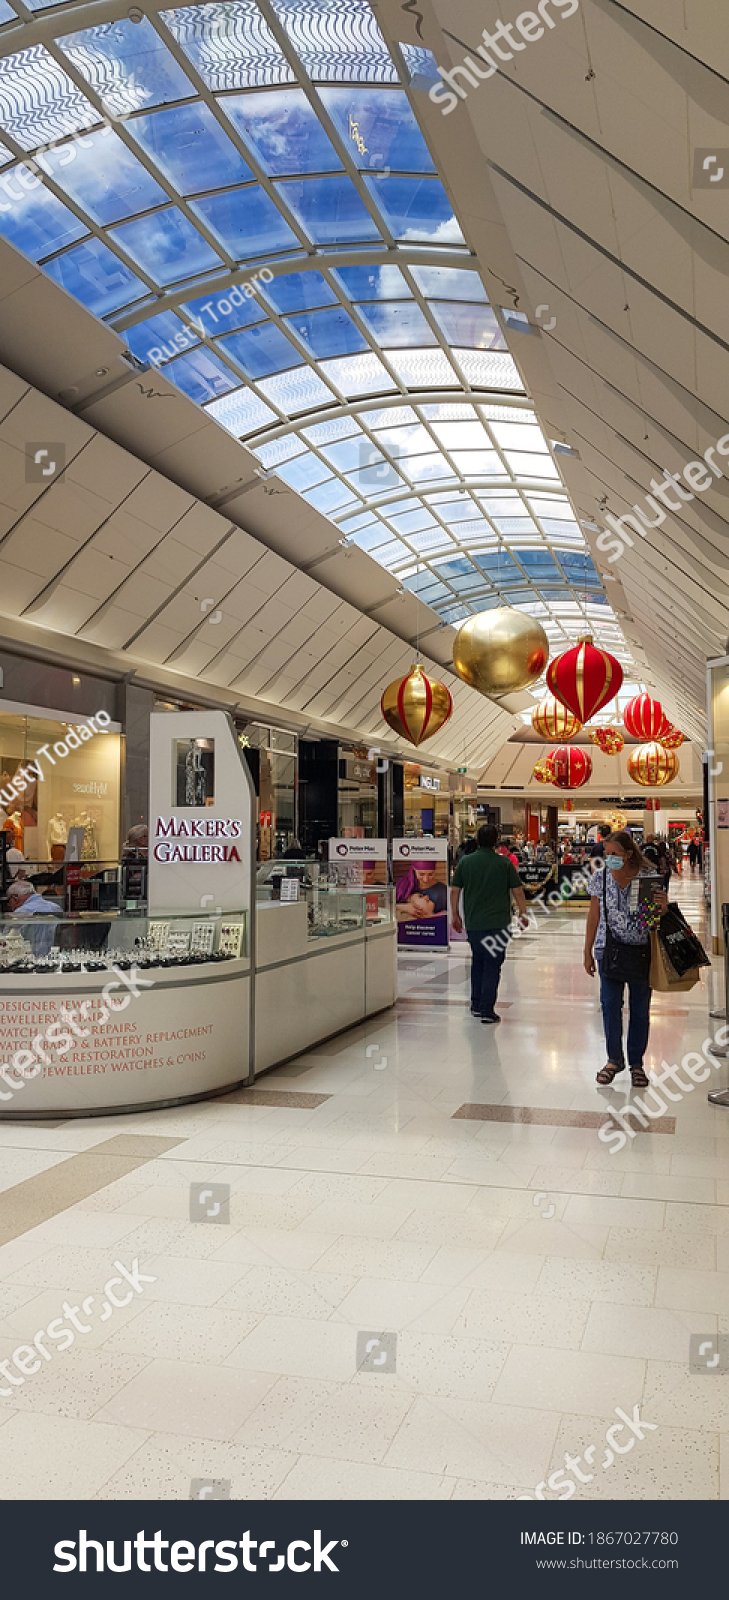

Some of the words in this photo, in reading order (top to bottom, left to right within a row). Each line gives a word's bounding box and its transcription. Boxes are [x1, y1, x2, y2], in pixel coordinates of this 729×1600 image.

[153, 842, 241, 864] GALLERIA
[80, 1038, 89, 1048] &
[94, 1034, 142, 1048] BATTERY
[146, 1024, 213, 1043] REPLACEMENT
[91, 1022, 137, 1035] REPAIRS
[60, 1054, 68, 1063] &
[73, 1047, 153, 1062] RESTORATION
[42, 1064, 108, 1078] JEWELLERY
[111, 1058, 164, 1072] WATCHES
[166, 1056, 175, 1067] &
